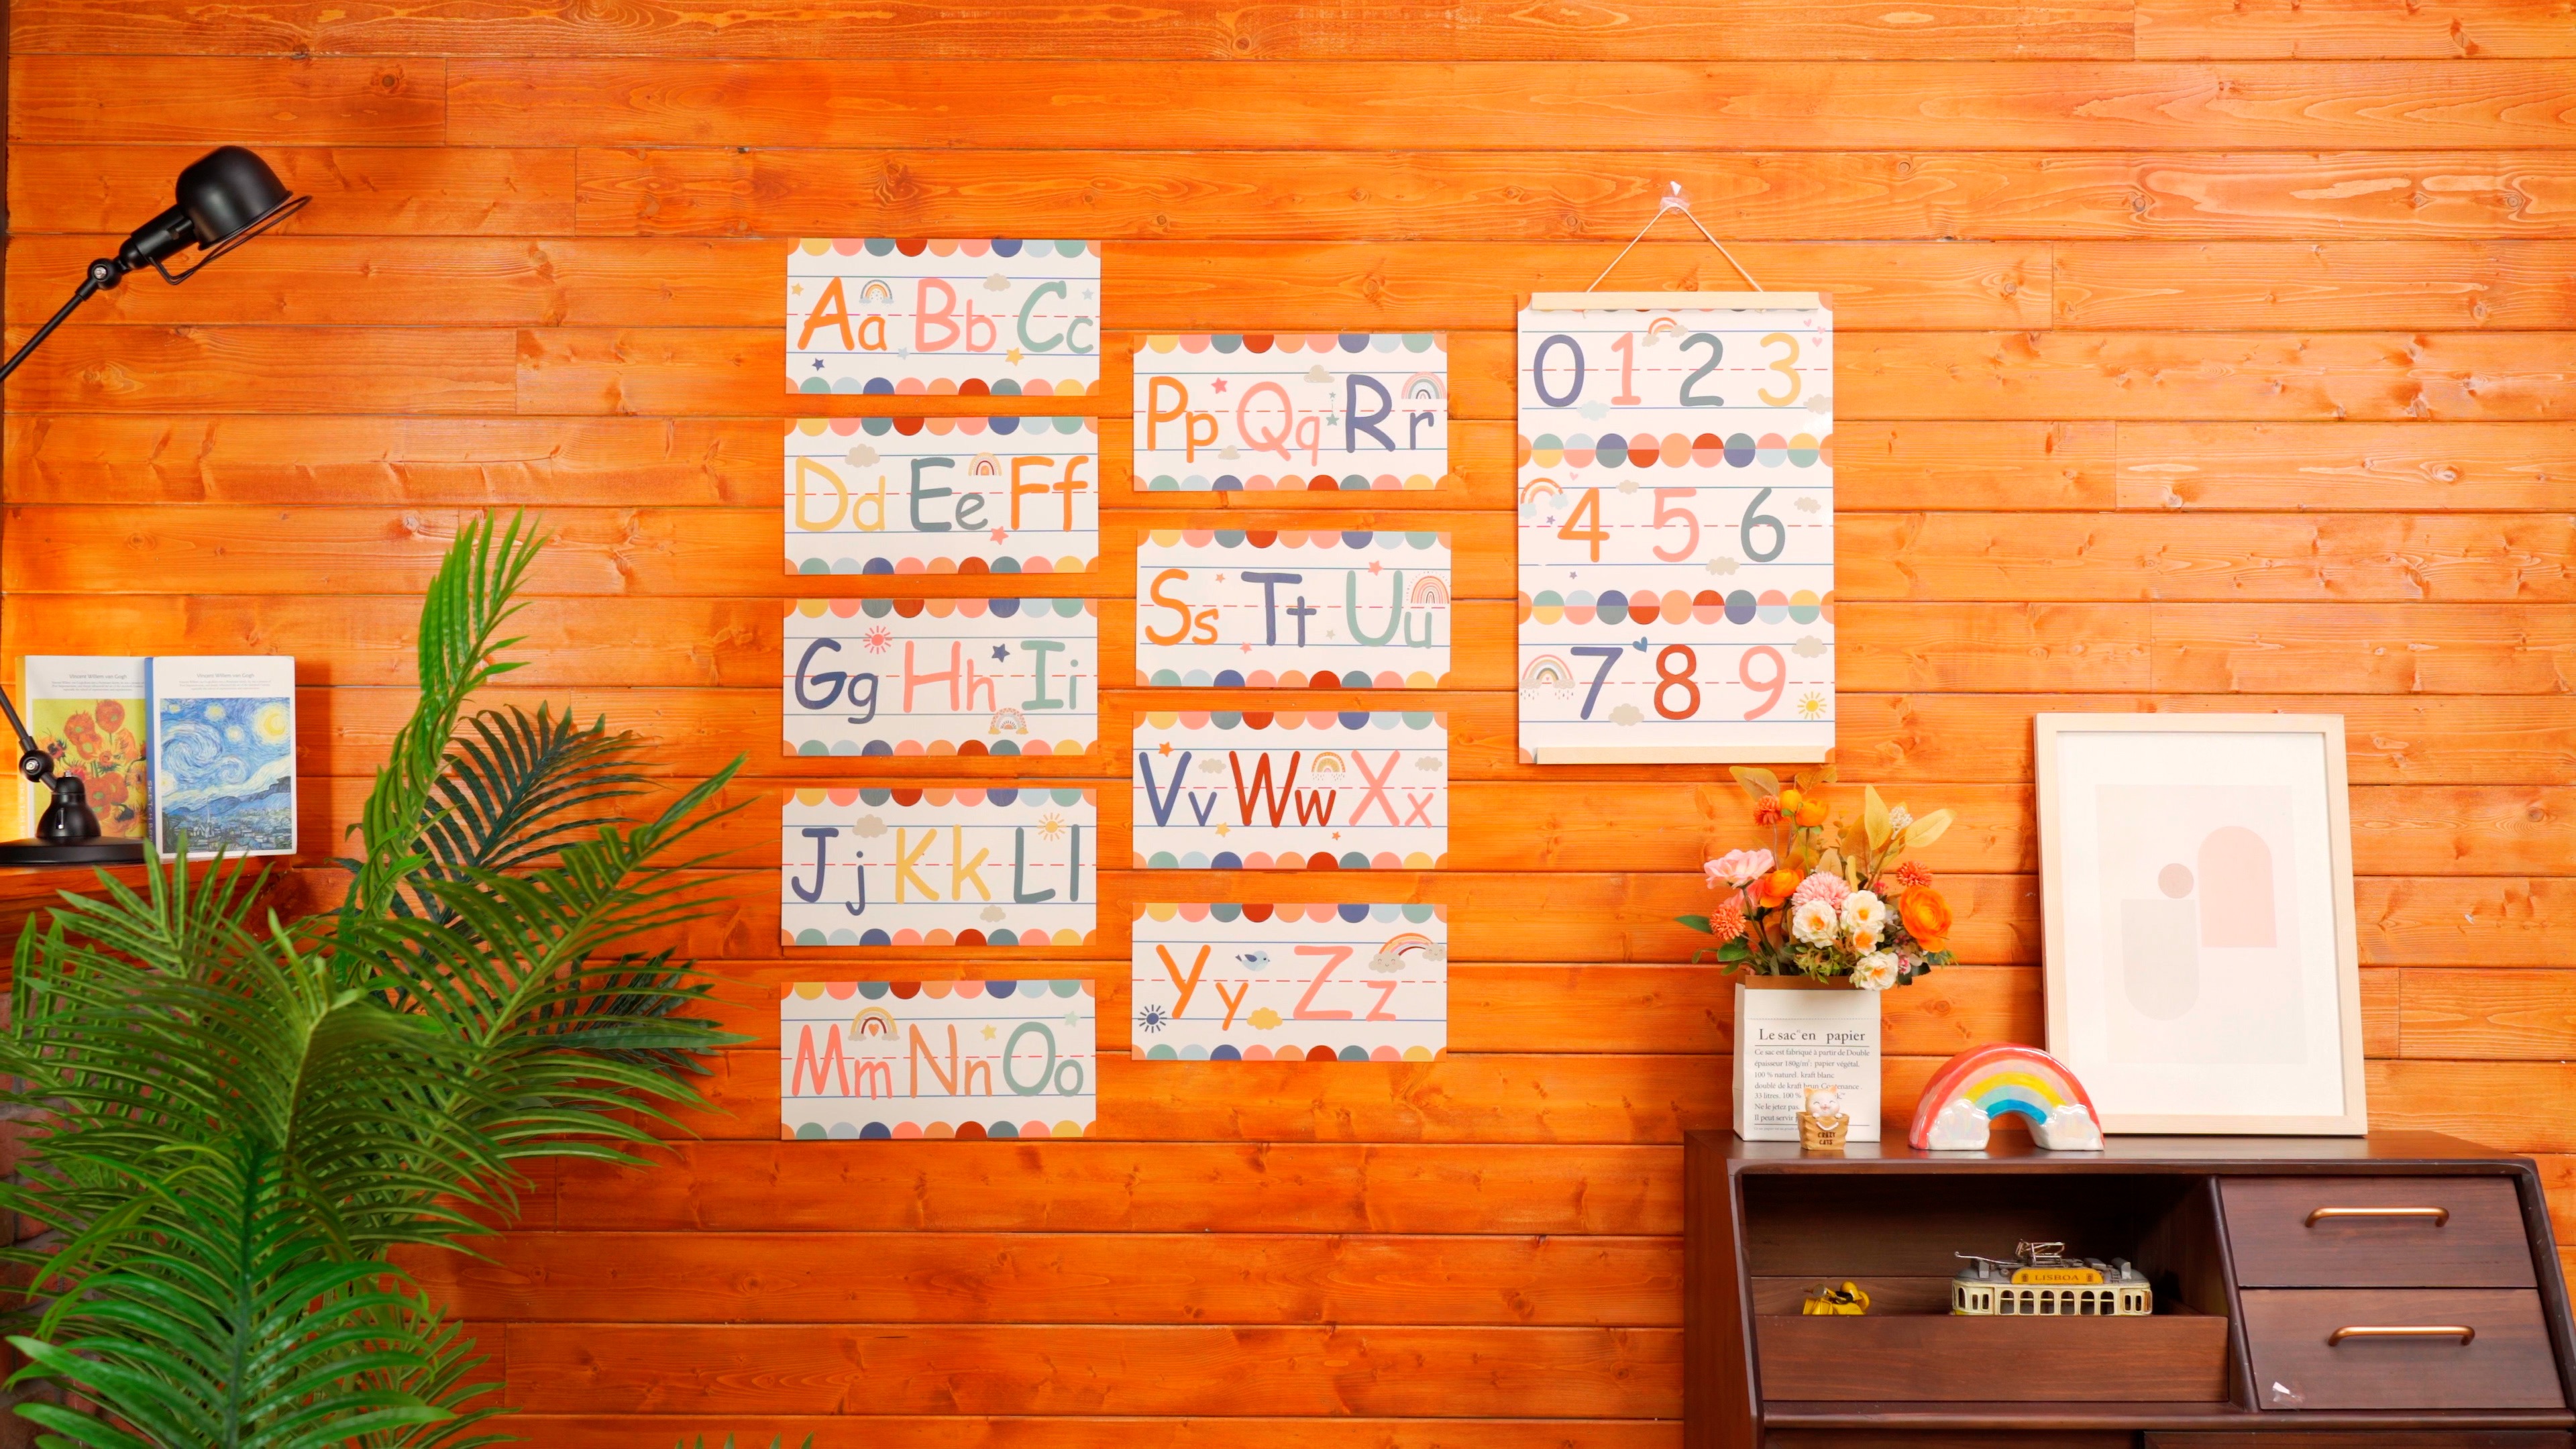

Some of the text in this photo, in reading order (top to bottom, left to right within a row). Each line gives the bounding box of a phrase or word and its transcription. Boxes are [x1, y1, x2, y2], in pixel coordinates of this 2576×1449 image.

[797, 276, 1094, 354] Aa Bb Cc
[1533, 331, 1802, 408] 0 1 2 3
[1147, 374, 1434, 467] Pp Qq Rr
[795, 455, 1089, 533] Dd Ee Ff
[1557, 486, 1786, 564] 4 5 6
[1144, 568, 1432, 649] Ss Tt Uu
[794, 637, 1079, 724] Gg Hh Ii
[1570, 643, 1787, 722] 7 8 9
[1138, 749, 1434, 829] Vv Ww Xx
[791, 824, 1080, 916] Jj Kk Ll
[1155, 944, 1397, 1032] Yy Zz
[791, 1021, 1084, 1100] Mm Nn Oo
[1759, 1028, 1775, 1040] Le
[1801, 1032, 1816, 1040] en
[1827, 1030, 1866, 1044] papier
[1786, 1049, 1812, 1057] fabriqué
[1819, 1049, 1836, 1058] partir
[1846, 1049, 1870, 1057] Double
